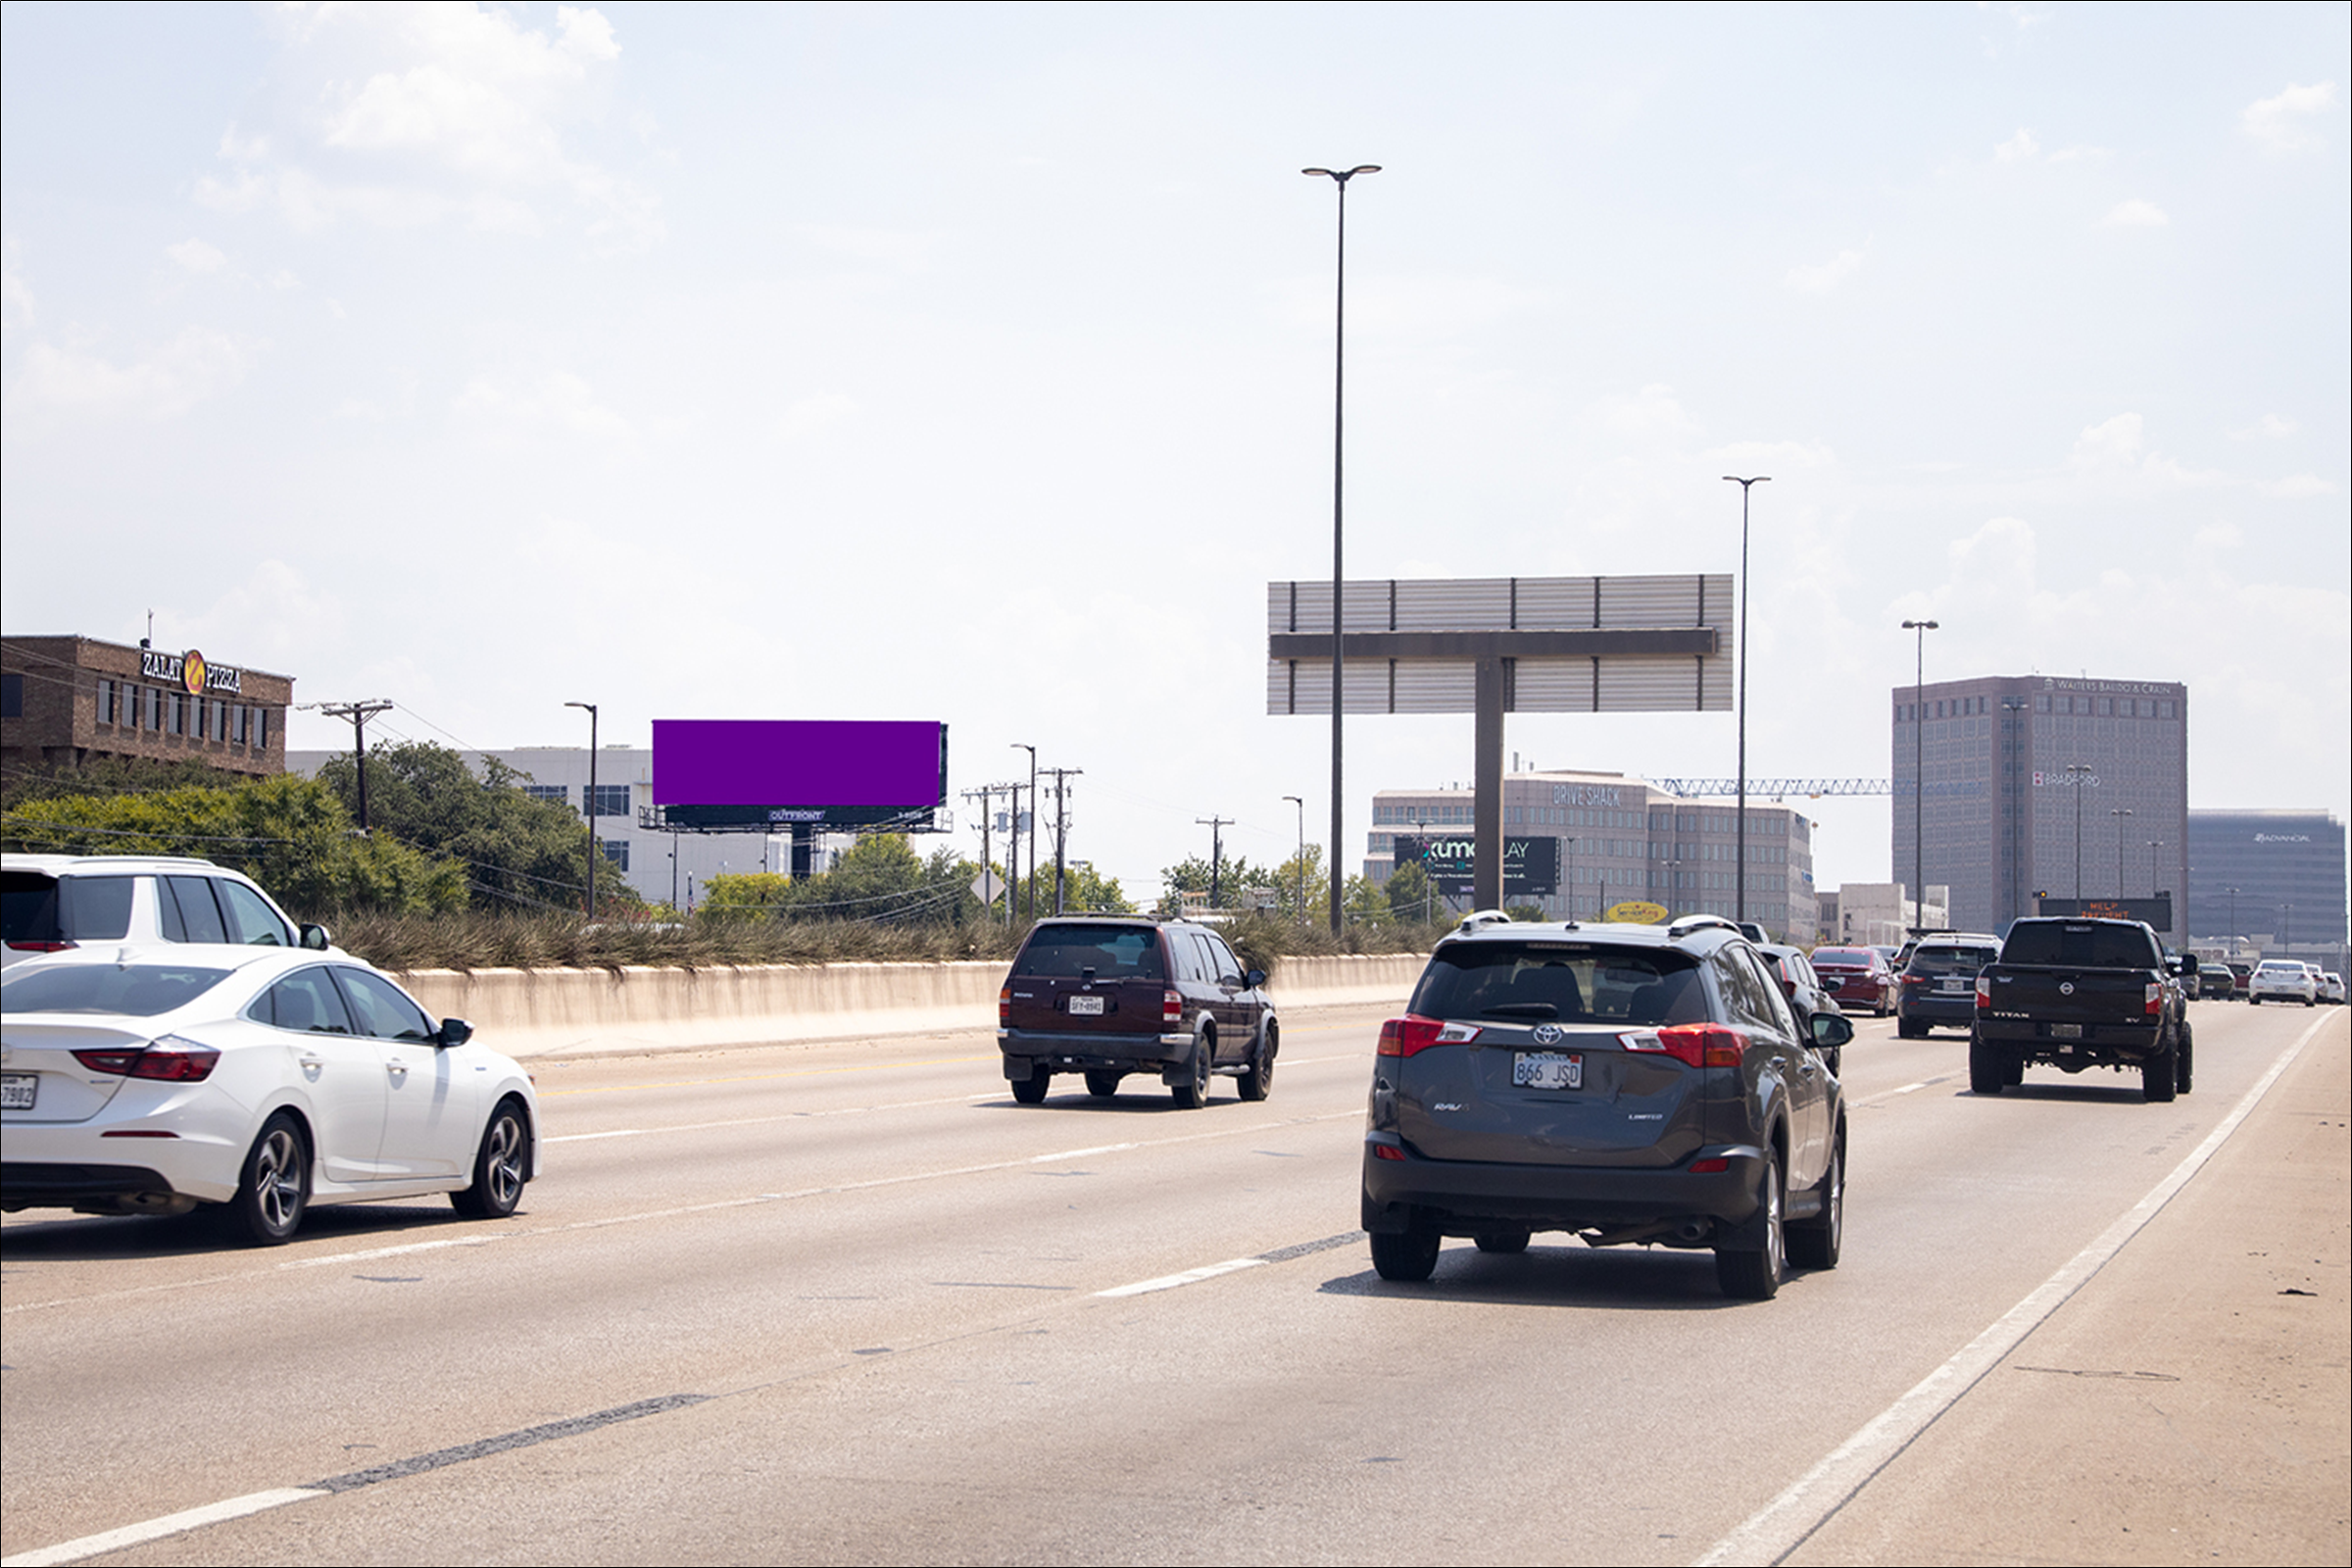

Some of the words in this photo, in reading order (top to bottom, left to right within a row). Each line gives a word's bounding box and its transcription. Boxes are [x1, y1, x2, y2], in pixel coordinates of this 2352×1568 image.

[143, 653, 183, 681] ZALAT
[206, 663, 242, 694] PIZZA
[2044, 772, 2100, 787] BRADFORD
[1553, 785, 1584, 806] DRIVE
[1586, 786, 1621, 808] SHACK
[768, 809, 825, 821] OUTFRONT
[1516, 1063, 1544, 1082] 866
[1552, 1064, 1579, 1083] JSD
[2, 1086, 34, 1103] 7902
